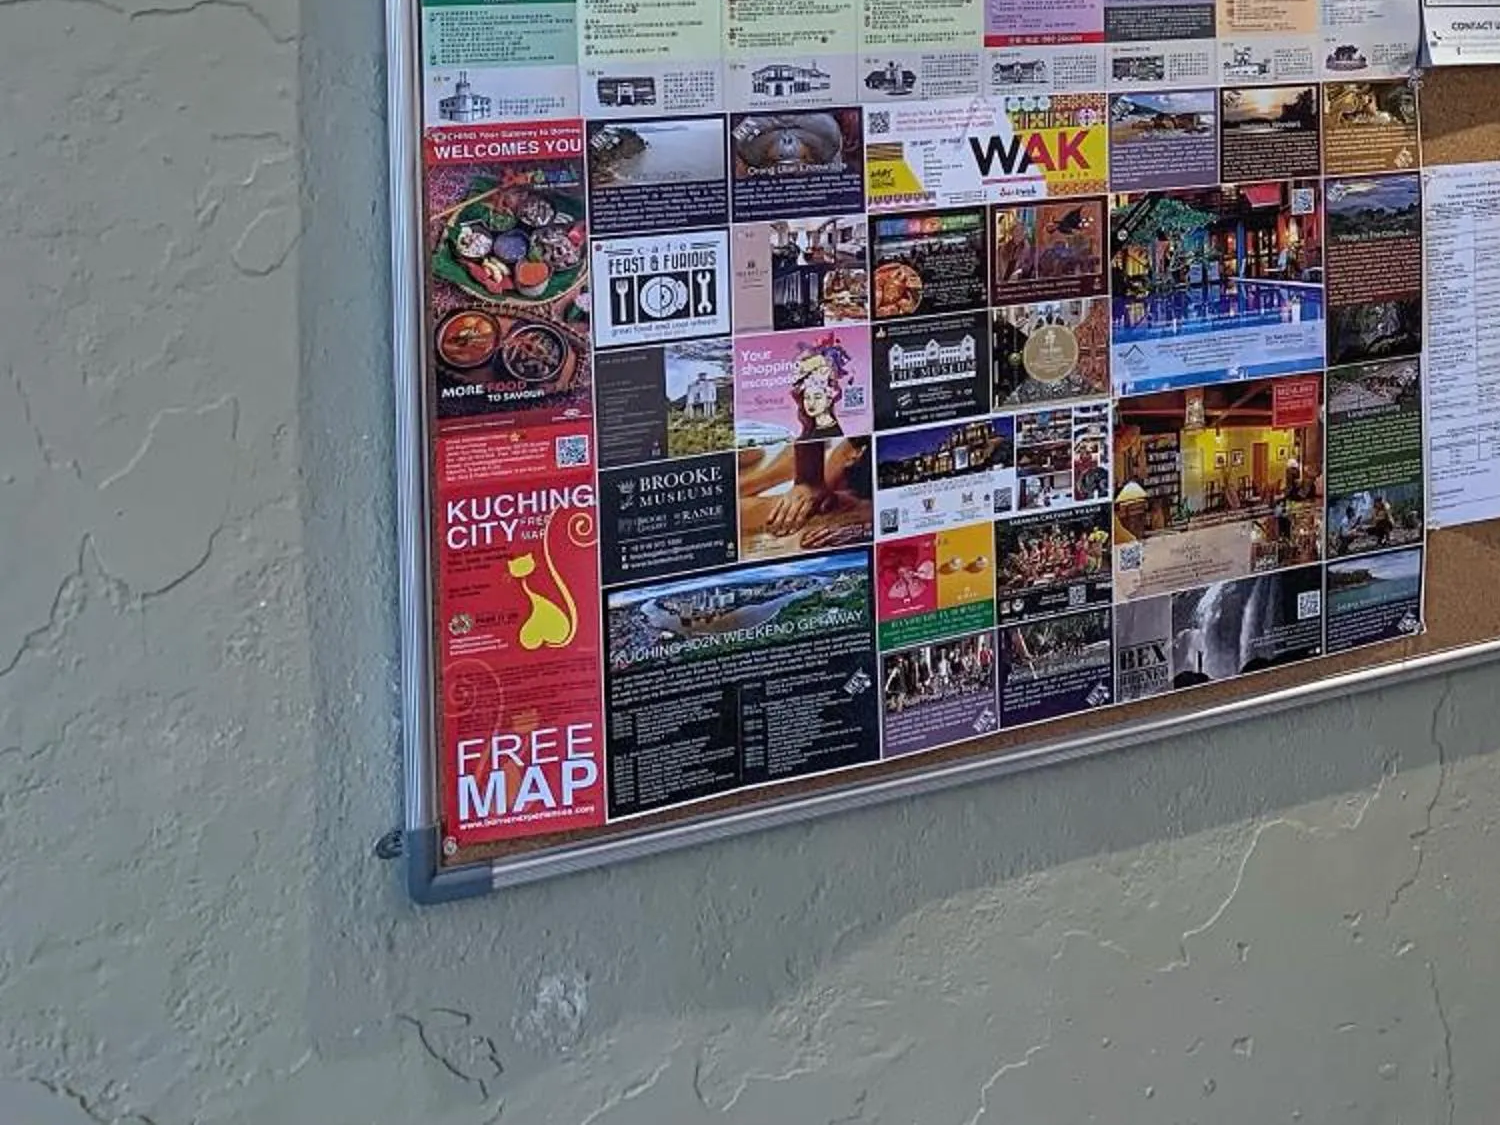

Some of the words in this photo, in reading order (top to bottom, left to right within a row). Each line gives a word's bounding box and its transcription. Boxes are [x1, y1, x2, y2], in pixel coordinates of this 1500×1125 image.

[434, 140, 539, 160] WELCOMES
[544, 138, 582, 153] YOU
[968, 130, 1092, 177] WAK
[609, 256, 645, 276] FEAST
[663, 250, 717, 270] FURIOUS
[740, 349, 771, 361] Your
[741, 360, 800, 376] shopping
[920, 361, 977, 377] MUSEUM
[441, 384, 485, 399] MORE
[487, 393, 501, 402] TO
[640, 466, 723, 492] BROOKE
[447, 484, 597, 524] KUCHING
[639, 485, 723, 507] MUSEUMS
[447, 518, 519, 550] CITY
[723, 622, 795, 645] WEEKEND
[456, 722, 595, 776] FREE
[458, 758, 599, 821] MAP
